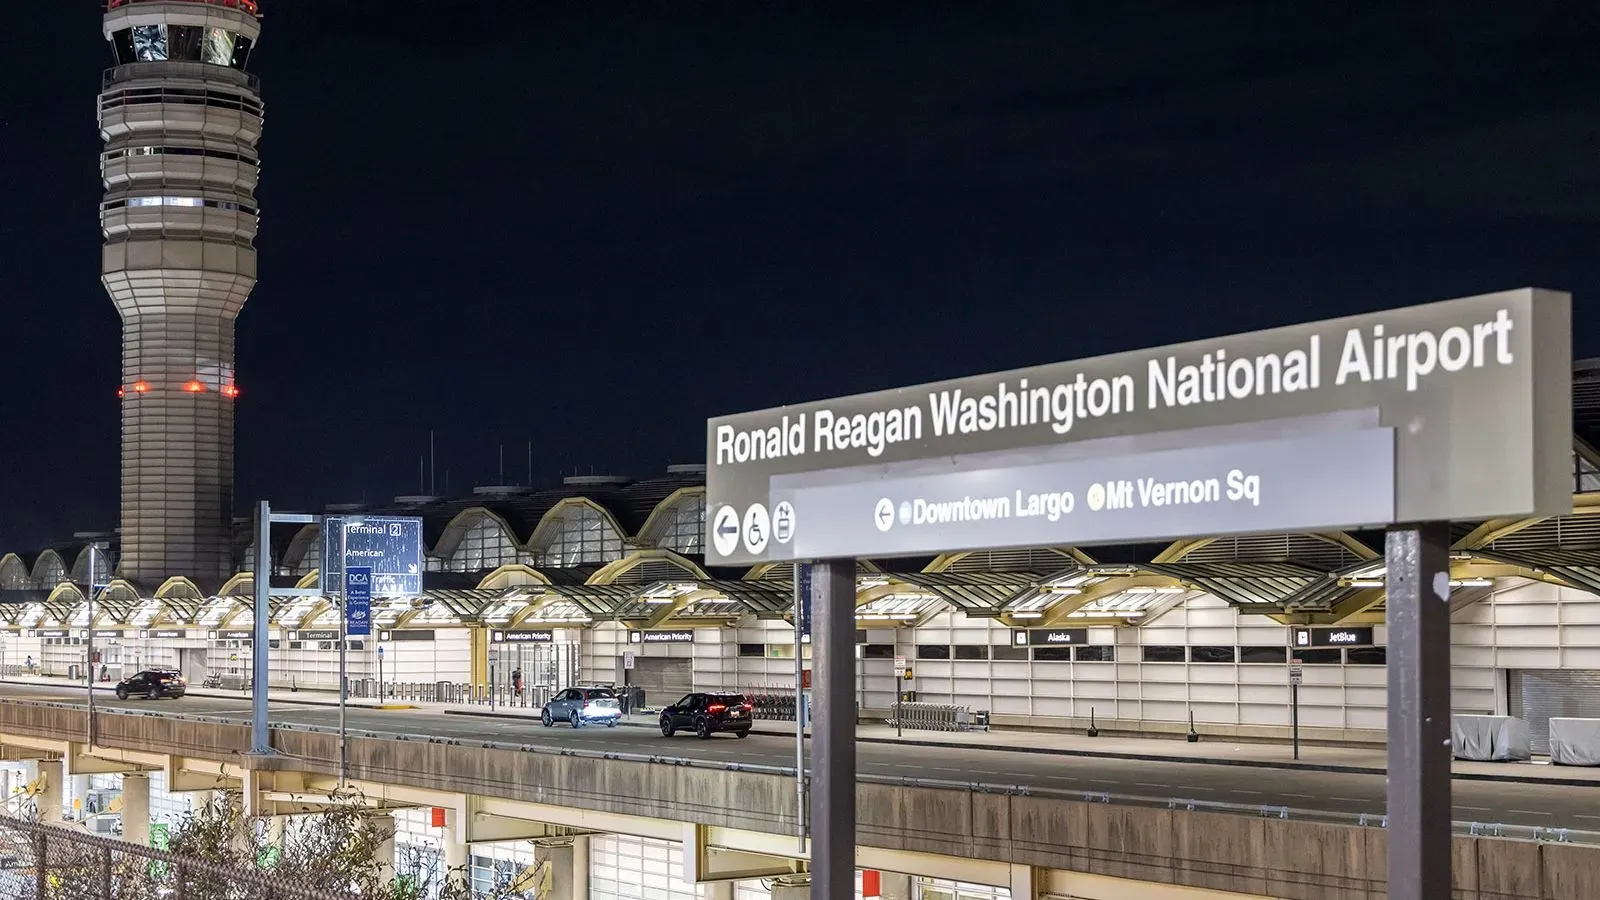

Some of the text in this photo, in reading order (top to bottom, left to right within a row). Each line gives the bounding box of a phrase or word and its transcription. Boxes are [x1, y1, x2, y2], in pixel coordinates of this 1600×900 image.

[716, 309, 1513, 465] Ronald Reagan Washington National Airport
[1106, 468, 1260, 510] Mt Vernon Sq
[912, 489, 1075, 525] Downtown Largo
[346, 524, 386, 534] Terminal
[346, 549, 384, 557] American
[349, 573, 368, 581] DCA
[371, 575, 396, 584] Traffic
[506, 632, 552, 641] American Priority
[644, 632, 693, 641] American Priority
[1047, 632, 1071, 642] Alaska
[1329, 631, 1356, 642] JetBlue
